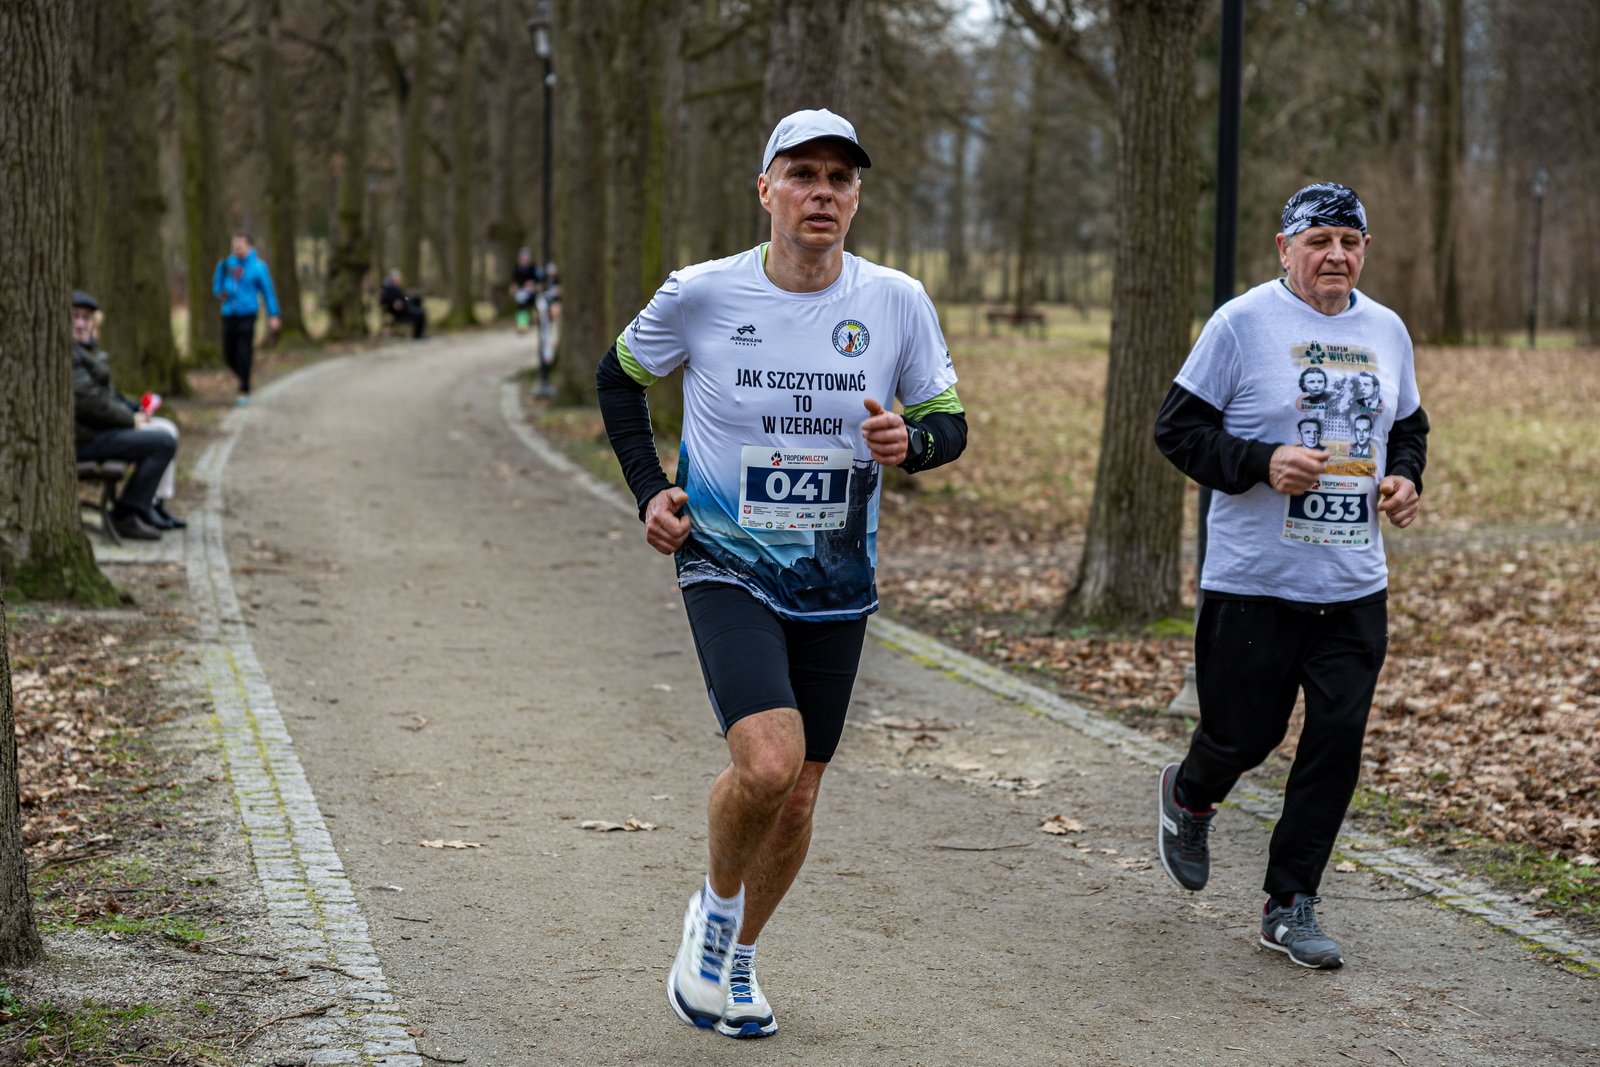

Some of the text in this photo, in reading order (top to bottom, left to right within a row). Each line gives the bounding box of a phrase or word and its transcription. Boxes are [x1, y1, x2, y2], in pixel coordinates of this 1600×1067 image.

[1328, 352, 1368, 363] WILCZYM
[735, 369, 866, 391] JAK SZCZYTOWAĆ
[793, 395, 812, 413] TO
[762, 415, 843, 435] W IZERACH
[765, 471, 832, 501] 041
[1303, 493, 1361, 521] 033
